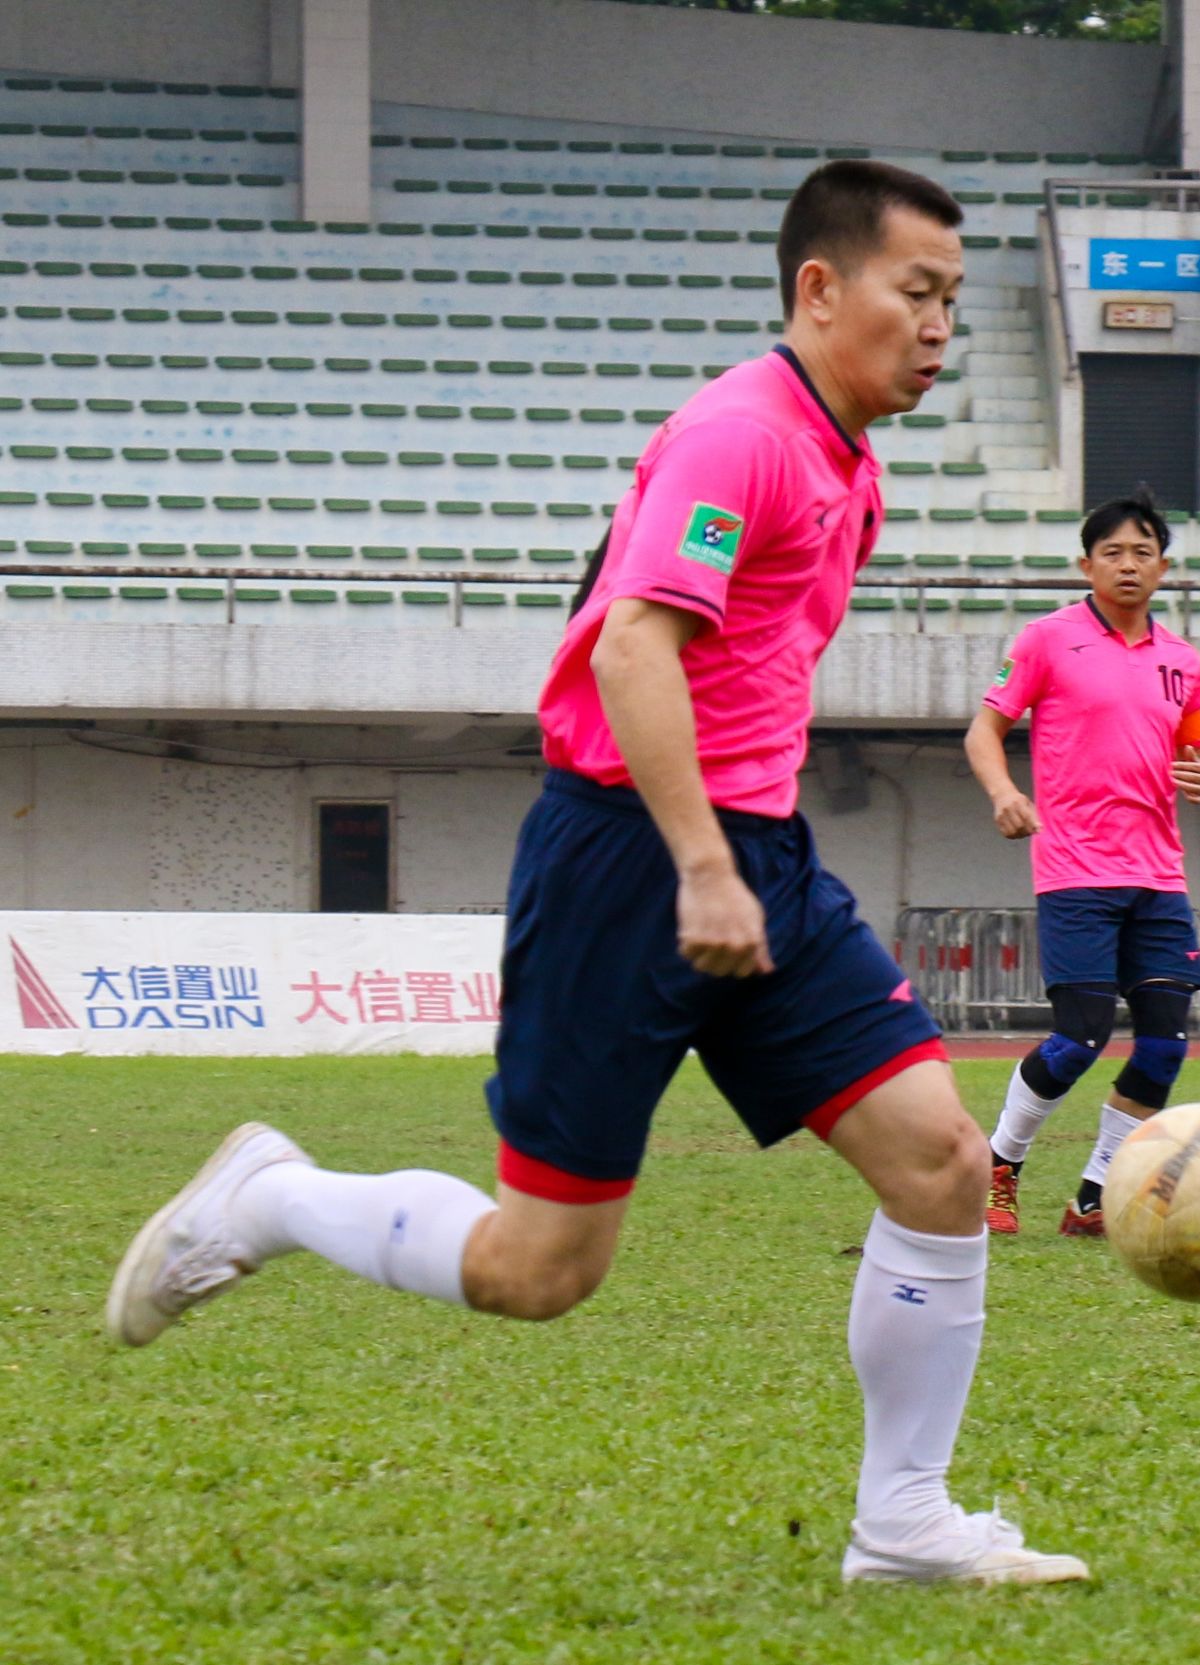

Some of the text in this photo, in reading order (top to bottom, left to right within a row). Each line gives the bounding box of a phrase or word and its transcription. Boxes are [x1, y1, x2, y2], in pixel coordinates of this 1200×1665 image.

[1158, 664, 1184, 707] 10
[82, 964, 260, 1001] 大信置业
[291, 968, 503, 1025] 大信置业
[88, 1004, 265, 1029] DASIN
